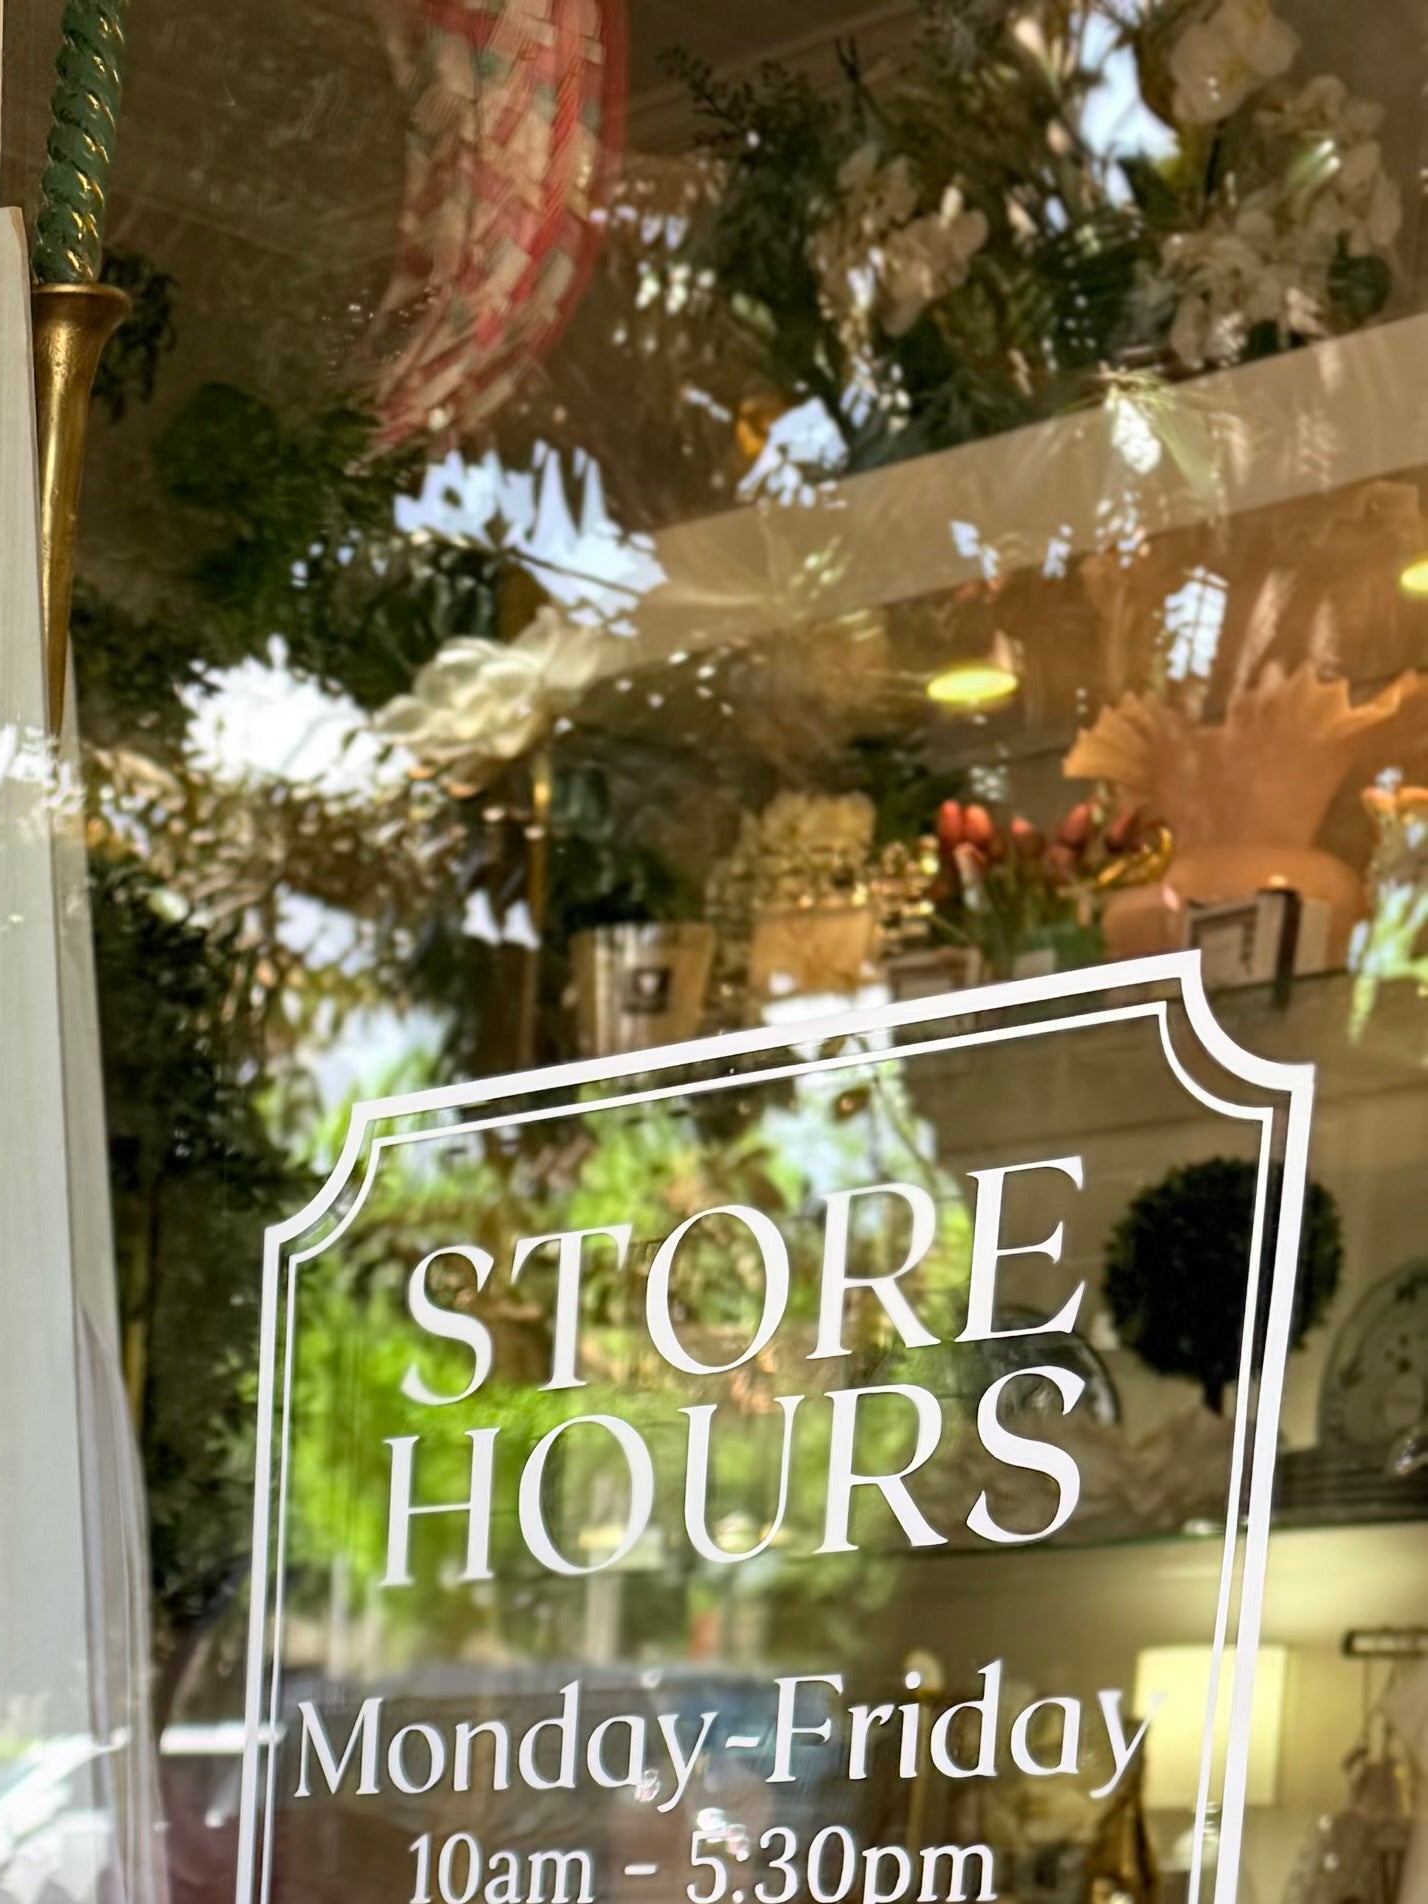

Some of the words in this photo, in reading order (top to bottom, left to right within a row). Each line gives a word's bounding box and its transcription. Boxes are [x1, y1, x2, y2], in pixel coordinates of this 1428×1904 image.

[399, 1154, 1086, 1406] STORE
[379, 1365, 1085, 1587] HOURS
[293, 1659, 1167, 1812] Monday-Friday
